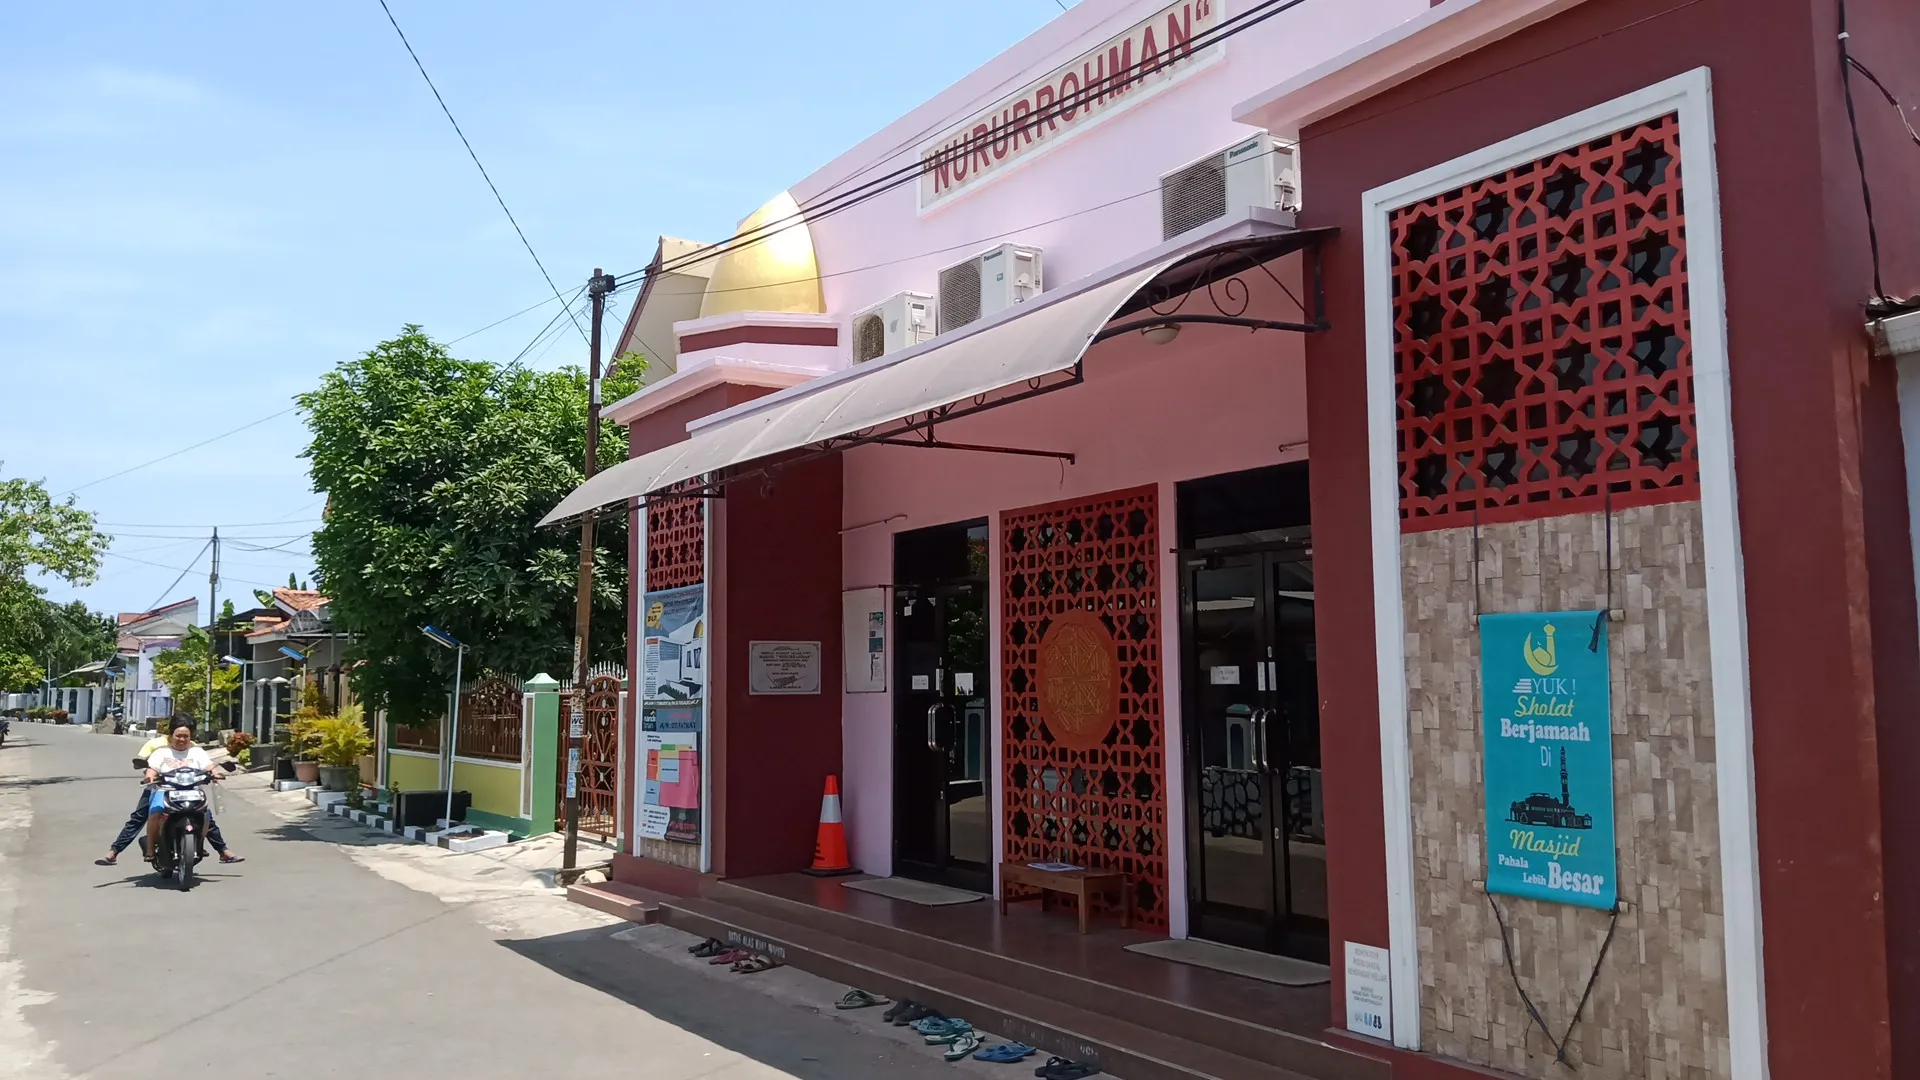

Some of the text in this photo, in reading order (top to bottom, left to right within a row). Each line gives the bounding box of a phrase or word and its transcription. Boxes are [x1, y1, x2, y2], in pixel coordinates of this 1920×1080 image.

[1229, 141, 1258, 158] Panasonic
[1532, 678, 1568, 695] YUK
[1514, 695, 1574, 717] Sholat
[571, 717, 584, 725] WC
[1500, 718, 1590, 743] Berjamaah
[1540, 745, 1552, 767] Di
[1509, 829, 1581, 860] Masjid
[1498, 854, 1529, 868] Pahala
[1522, 861, 1604, 895] Lebih Besar
